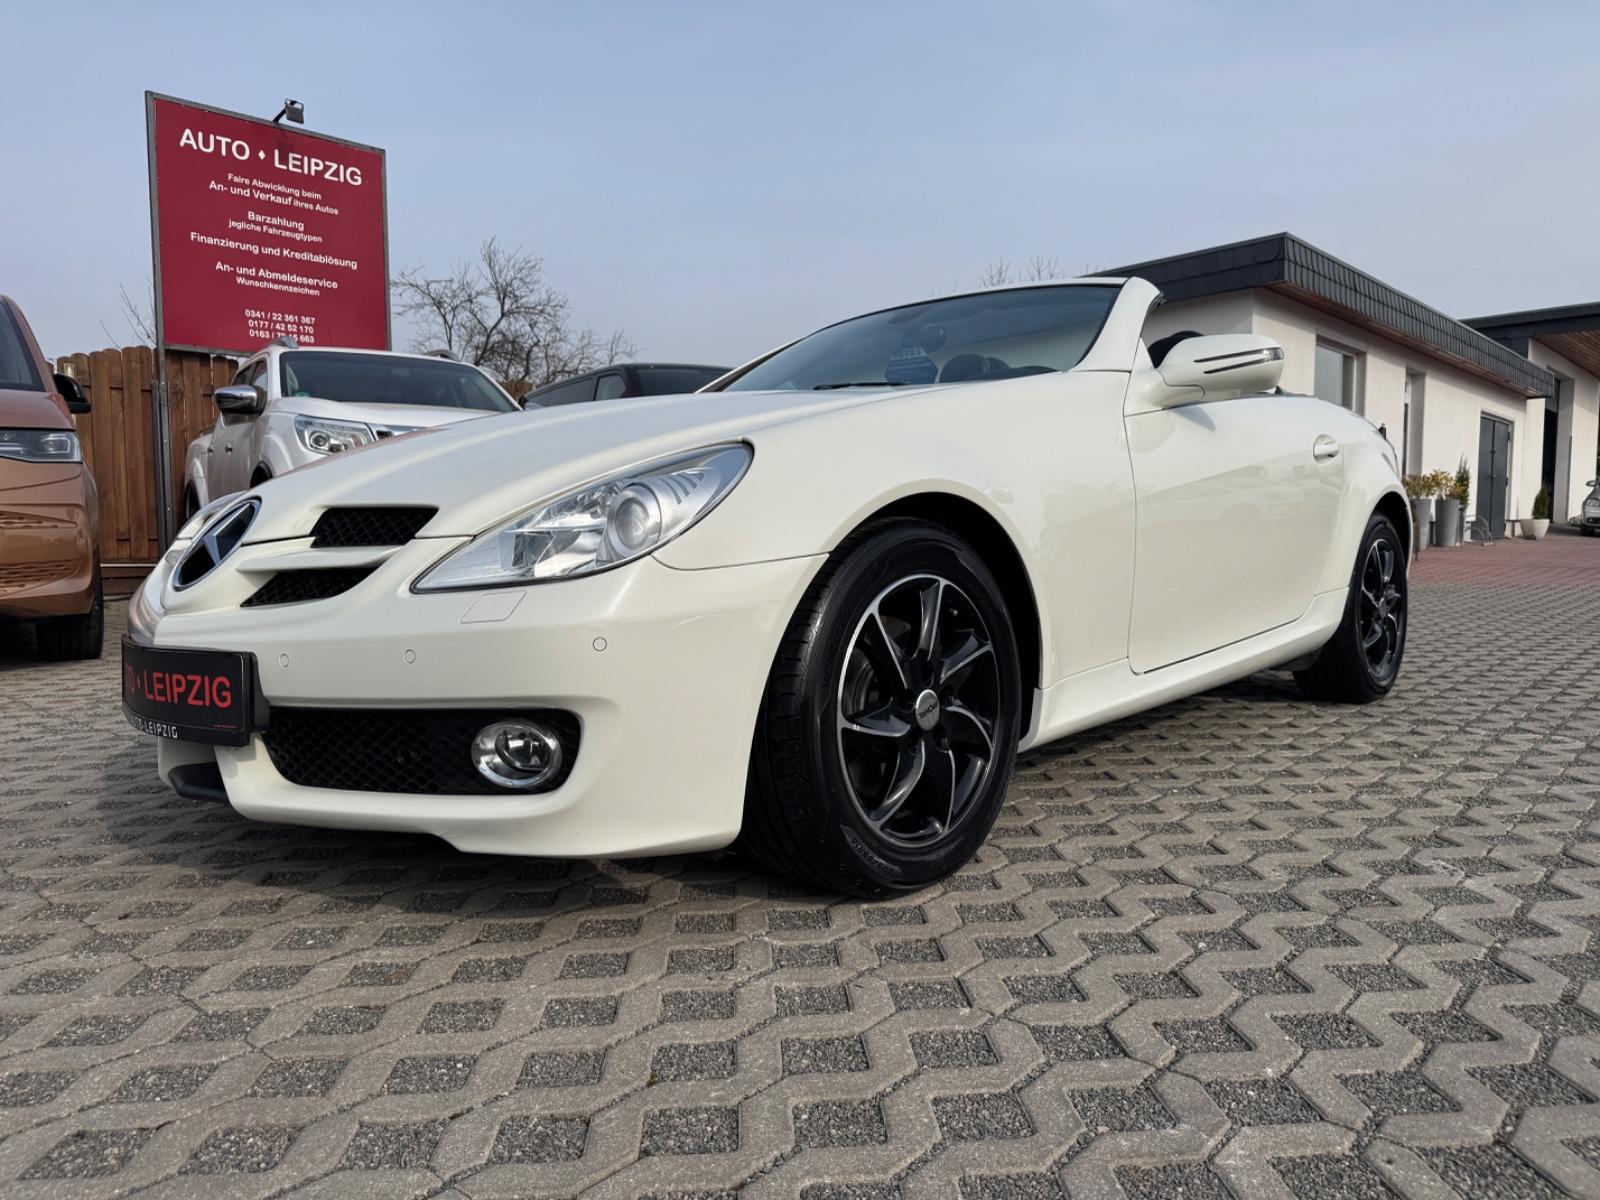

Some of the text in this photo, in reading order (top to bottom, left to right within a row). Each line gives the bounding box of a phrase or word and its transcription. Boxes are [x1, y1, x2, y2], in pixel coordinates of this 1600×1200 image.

[179, 128, 363, 186] AUTO LEIPZIG
[209, 180, 228, 192] An-
[230, 186, 250, 197] und
[253, 189, 293, 206] Verkauf
[315, 204, 339, 215] Autos
[227, 173, 322, 200] Faire Abwicklung beim
[228, 219, 323, 243] jegliche Fahrzeugtypen
[248, 211, 305, 231] Barzahlung
[190, 231, 358, 270] Finanzierung und Kreditablösung
[215, 261, 338, 289] An- und Abmeldeservice
[235, 276, 321, 297] Wunschkennzeichen
[245, 309, 266, 319] 0341
[272, 312, 283, 321] 22
[284, 314, 299, 323] 361
[300, 316, 316, 325] 367
[248, 319, 269, 329] 0177
[275, 323, 286, 331] 42
[299, 326, 314, 334] 170
[249, 329, 270, 339] 0163
[144, 671, 232, 709] LEIPZIG
